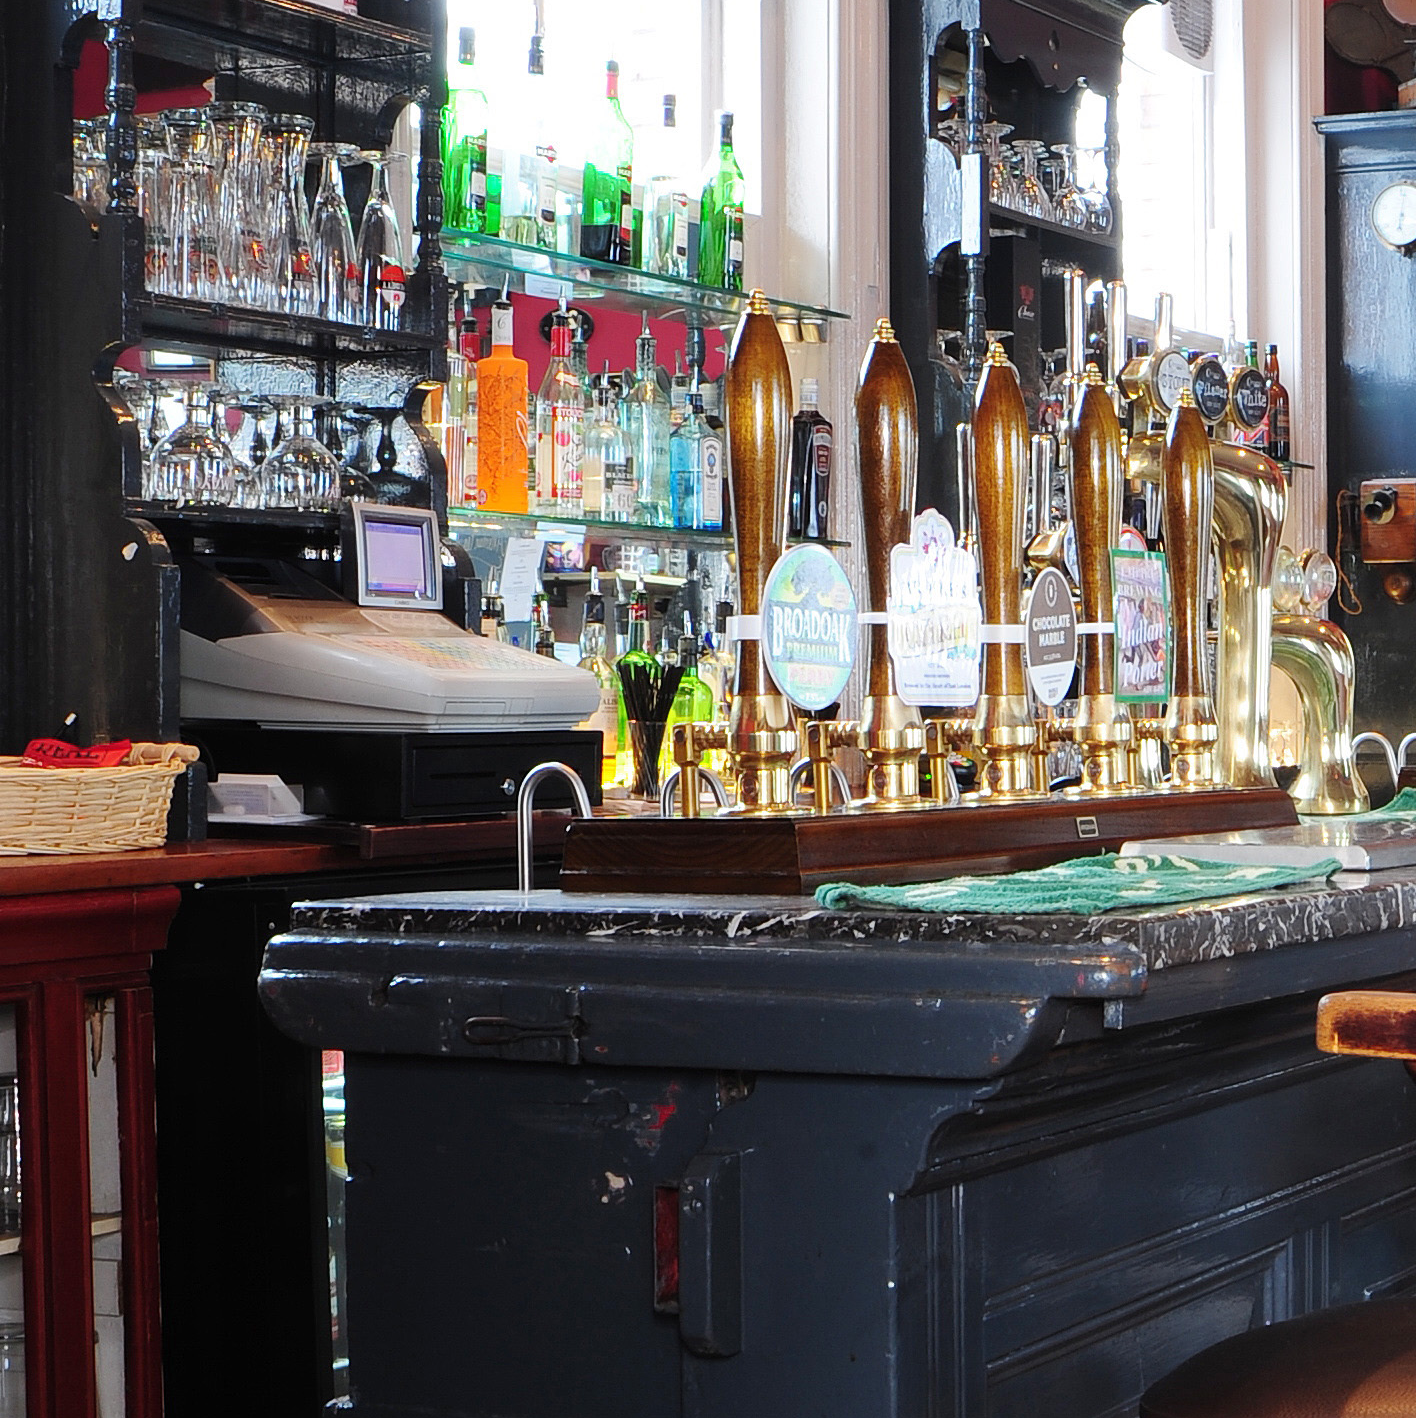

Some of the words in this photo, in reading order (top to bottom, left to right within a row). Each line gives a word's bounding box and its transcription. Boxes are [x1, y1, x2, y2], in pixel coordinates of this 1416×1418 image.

[1117, 584, 1162, 597] BREWING
[1032, 614, 1071, 631] CHOCOLATE
[772, 605, 851, 664] BROADOAK
